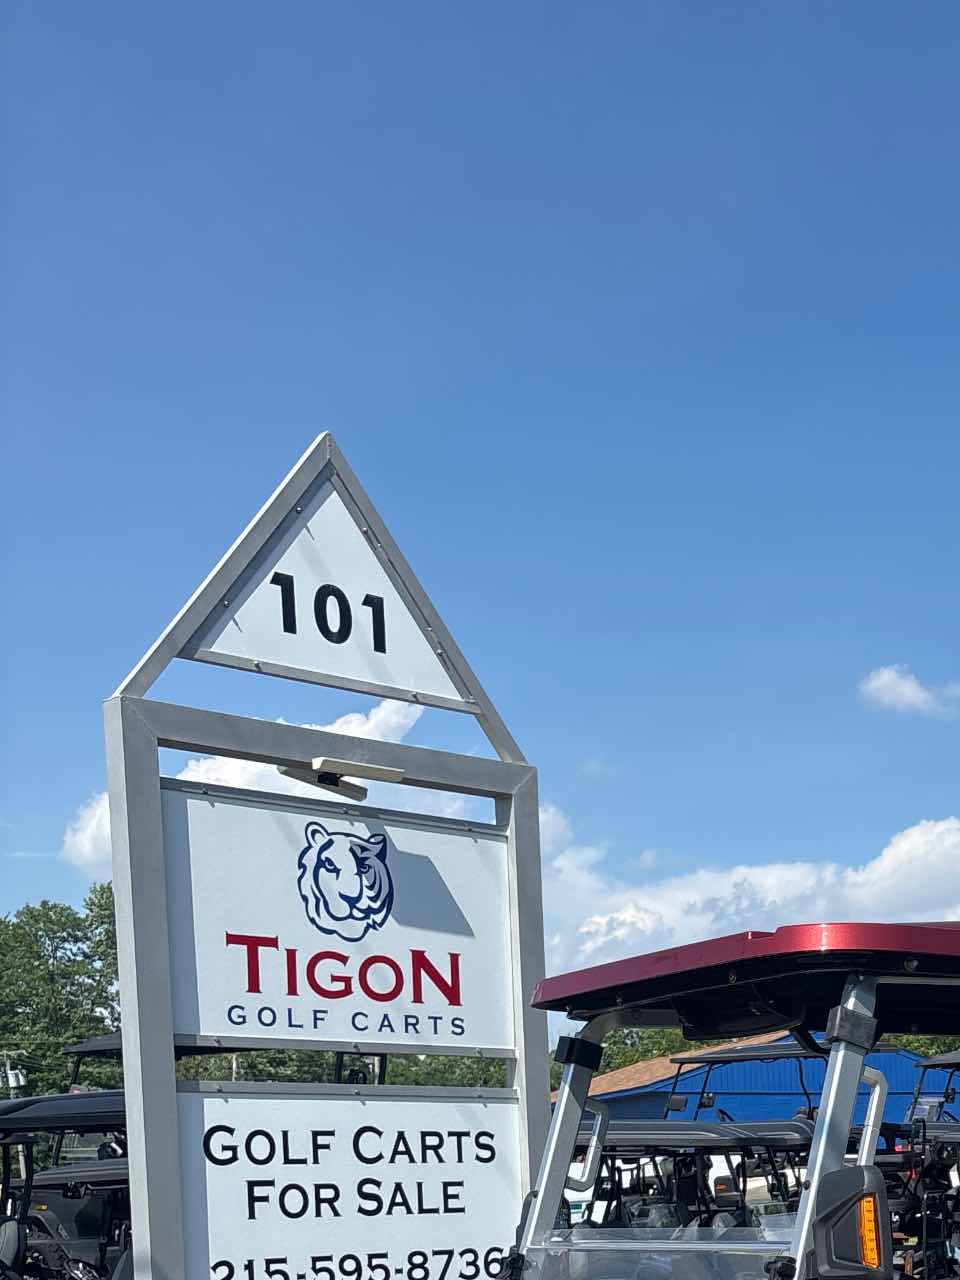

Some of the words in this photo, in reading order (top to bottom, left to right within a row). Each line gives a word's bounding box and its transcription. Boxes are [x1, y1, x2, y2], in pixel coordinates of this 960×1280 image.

[270, 572, 387, 653] 101
[225, 932, 462, 1006] TIGON
[227, 1005, 327, 1030] GOLF
[351, 1011, 466, 1036] CARTS
[202, 1125, 336, 1166] GOLF
[352, 1126, 496, 1165] CARTS
[246, 1179, 342, 1220] FOR
[357, 1178, 466, 1217] SALE
